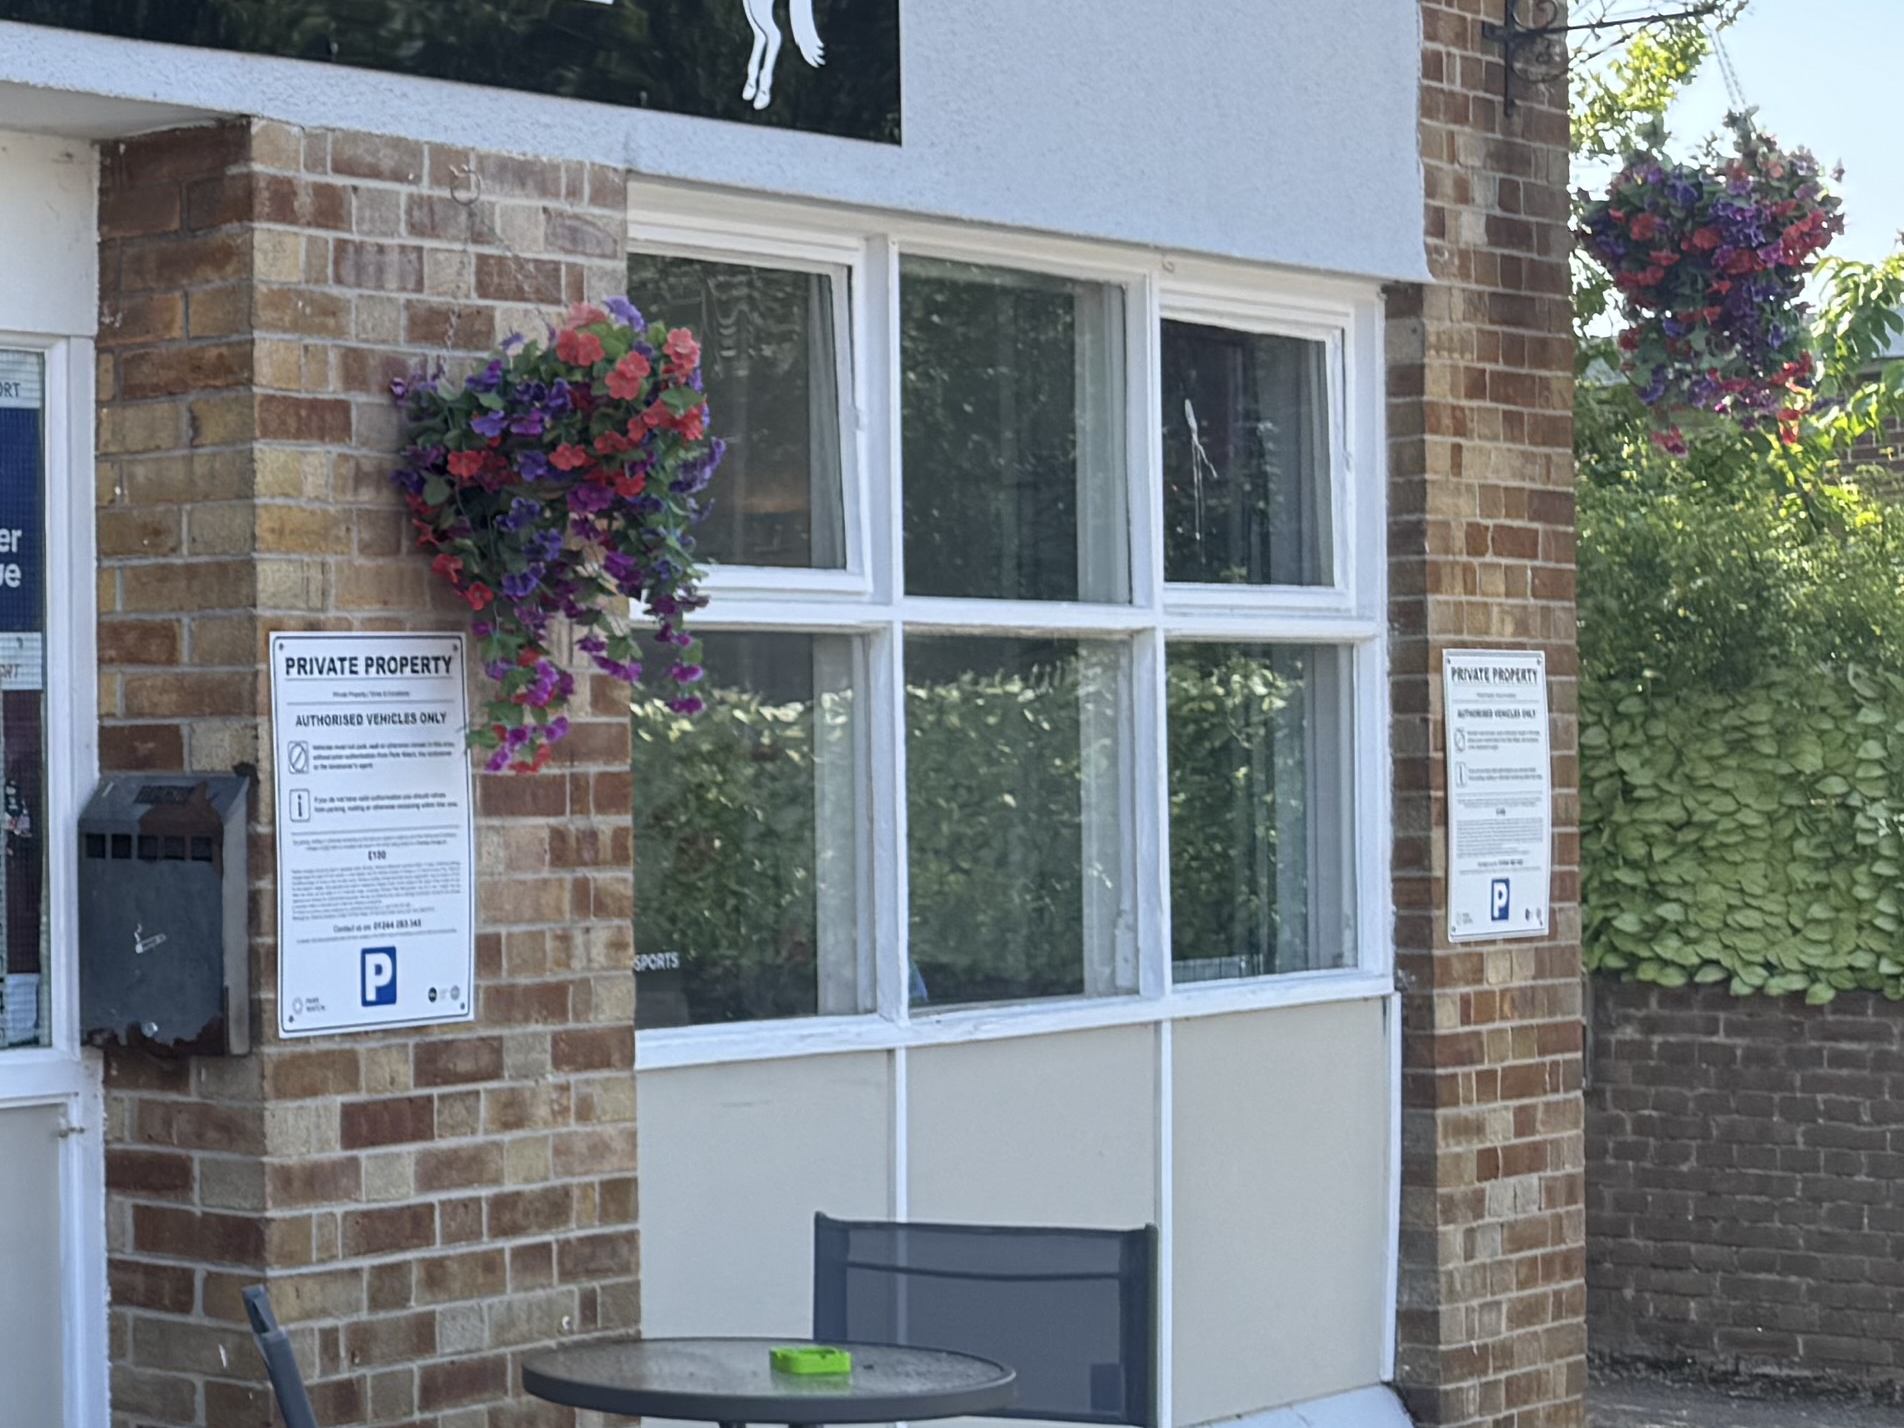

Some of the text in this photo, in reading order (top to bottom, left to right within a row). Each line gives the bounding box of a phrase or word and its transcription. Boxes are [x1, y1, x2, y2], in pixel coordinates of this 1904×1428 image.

[285, 654, 452, 677] PRIVATE PROPERTY
[295, 711, 447, 728] AUTHORISED VEHICLES ONLY
